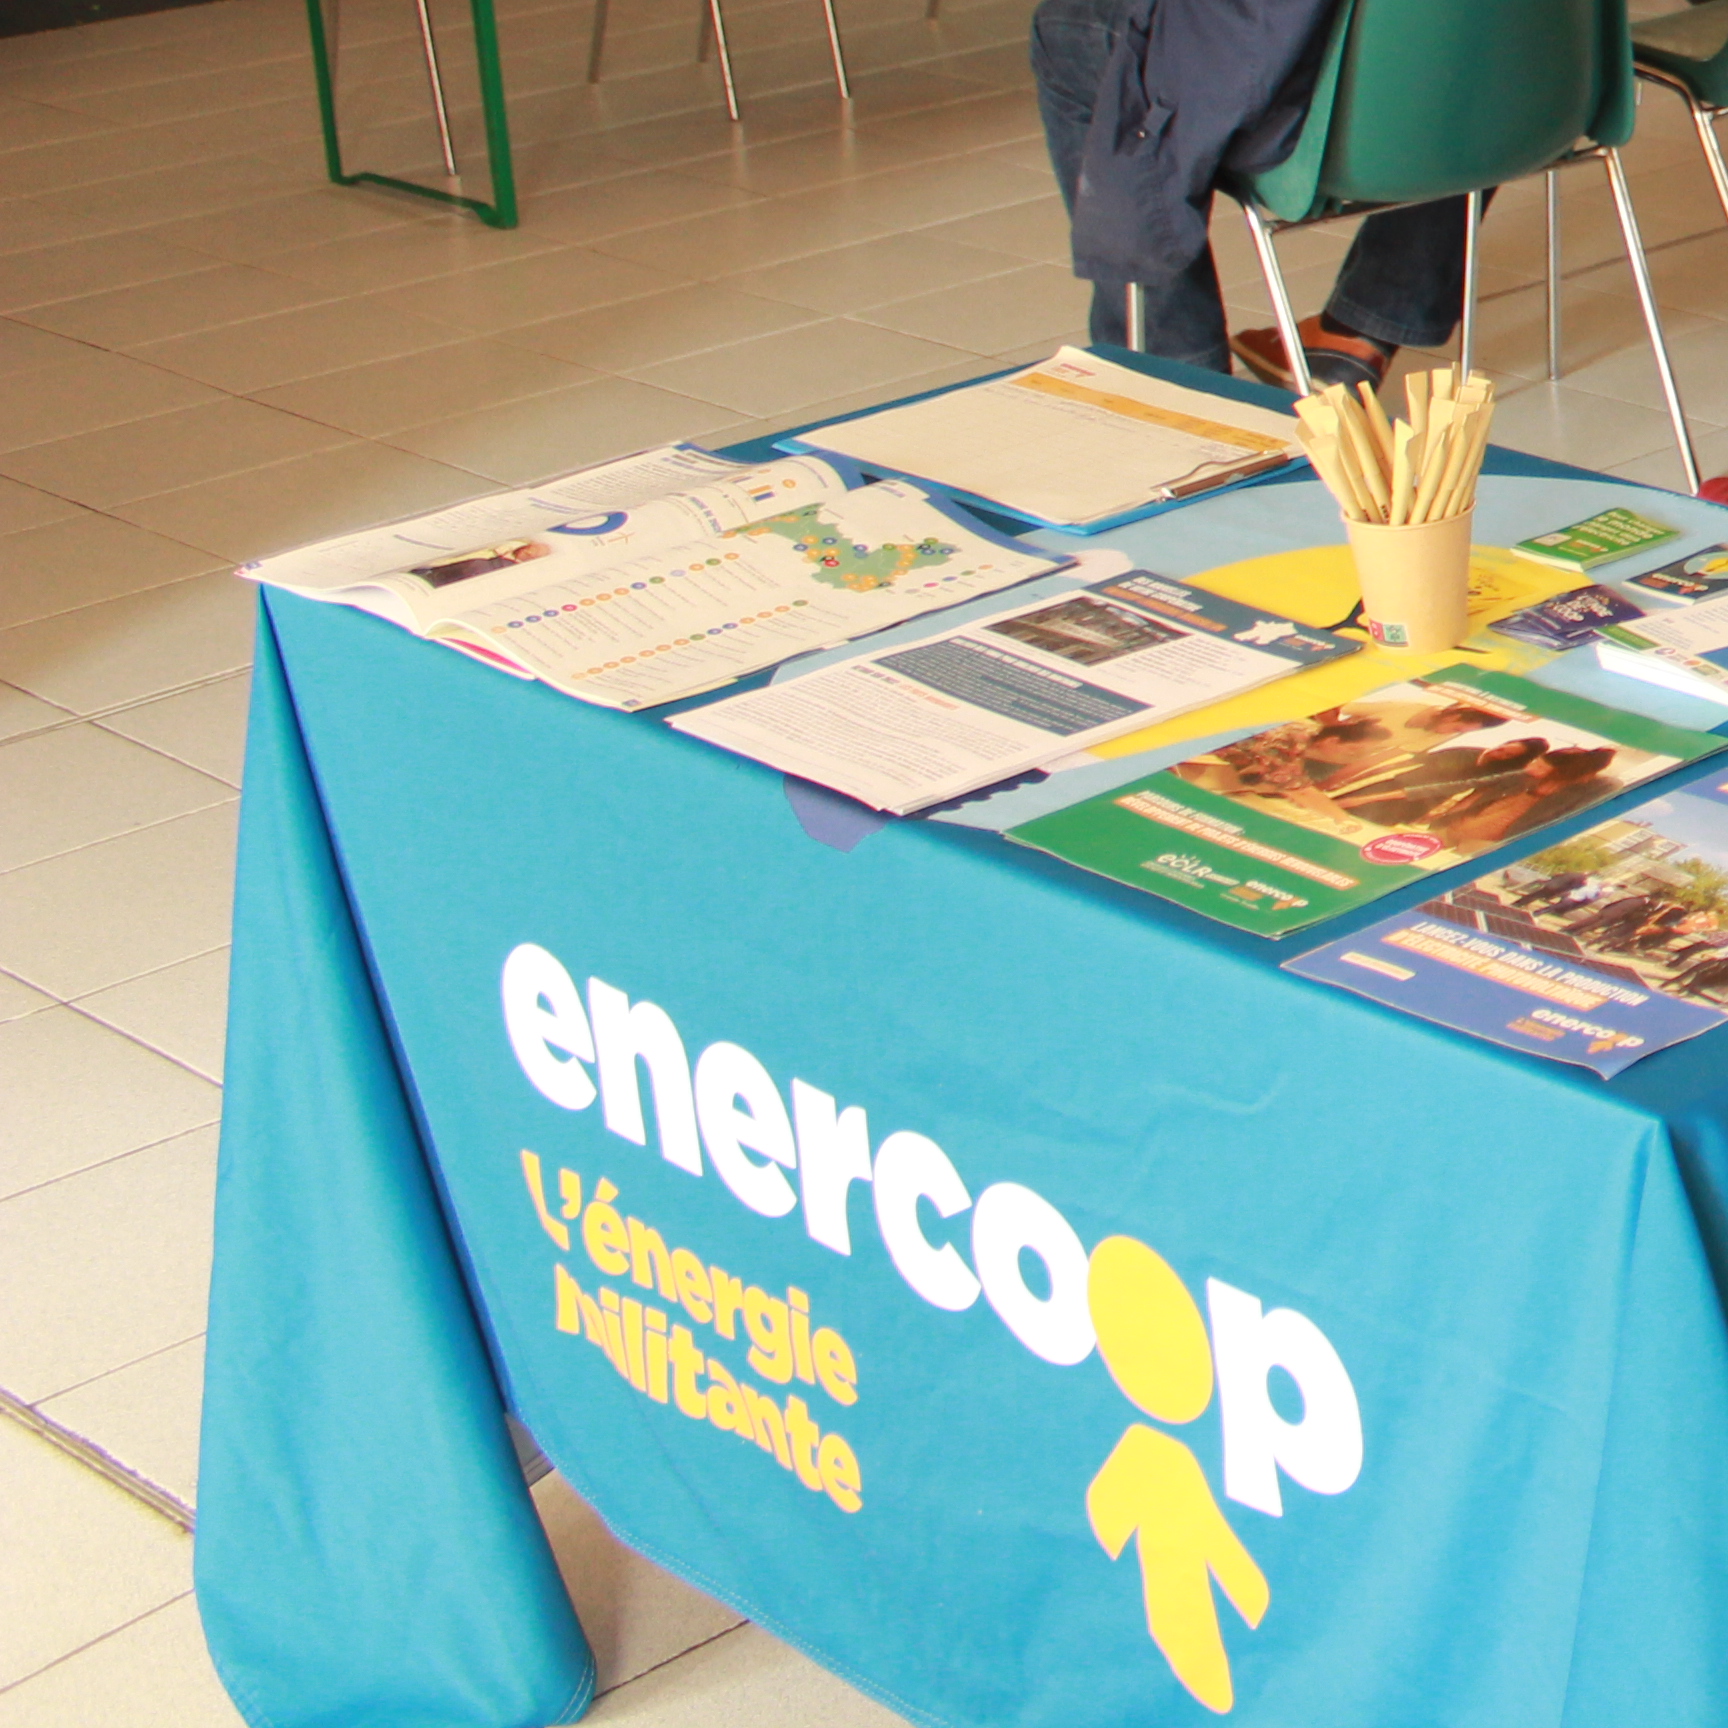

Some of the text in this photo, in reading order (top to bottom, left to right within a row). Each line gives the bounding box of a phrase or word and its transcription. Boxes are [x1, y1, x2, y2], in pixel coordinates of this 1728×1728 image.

[1390, 929, 1491, 972] D'ÉLECTRICITÉ
[1480, 960, 1604, 1010] PHOTOVOLTAÏQUE
[1410, 920, 1650, 1009] LANCEZ-VOUS DANS LA PRODUCTION
[1531, 1008, 1645, 1048] enercoop
[500, 942, 1364, 1517] enercoop
[519, 1148, 859, 1407] L'énergie
[554, 1263, 863, 1514] militante
